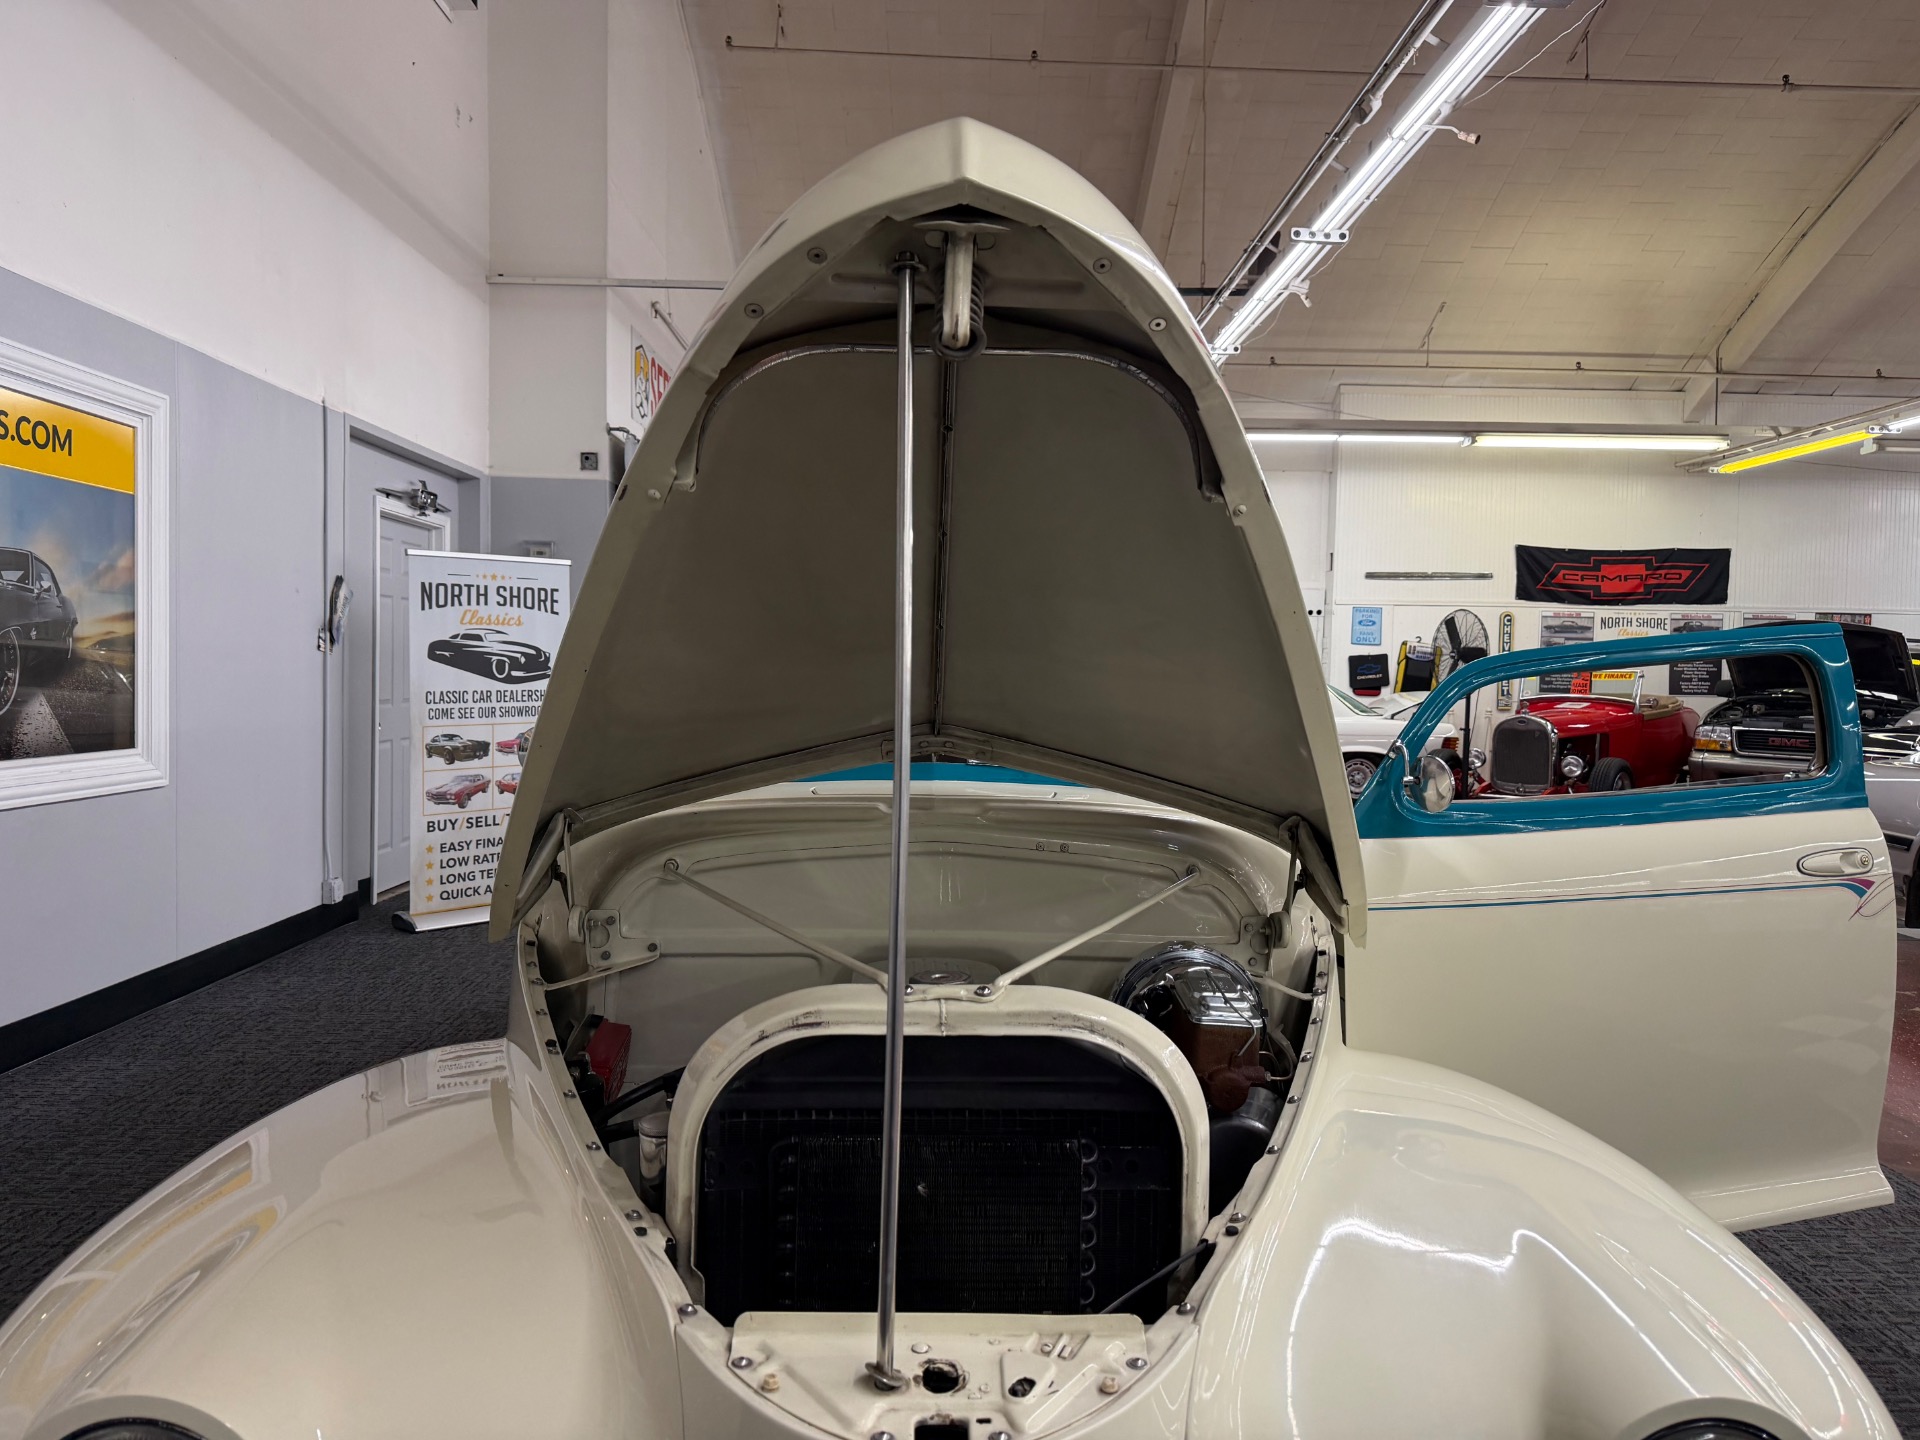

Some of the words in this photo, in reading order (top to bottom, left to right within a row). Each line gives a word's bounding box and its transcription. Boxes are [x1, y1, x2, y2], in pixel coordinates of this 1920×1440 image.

[651, 356, 671, 417] SE
[1562, 572, 1683, 583] CAMARO
[420, 581, 489, 612] NORTH
[496, 585, 560, 616] SHORE
[459, 609, 524, 627] Classics
[1600, 616, 1633, 630] NORTH
[1636, 617, 1668, 631] SHORE
[1617, 628, 1649, 637] Classics
[1502, 616, 1511, 696] CHEVET
[425, 690, 469, 705] CLASSIC
[472, 690, 493, 704] CAR
[428, 707, 455, 720] COME
[458, 707, 475, 720] SEE
[478, 706, 497, 719] OUR
[1768, 737, 1810, 748] GMC
[426, 813, 511, 833] BUY/SELL/
[440, 839, 472, 853] EASY
[440, 856, 470, 870] LOW
[440, 871, 476, 886] LONG
[479, 868, 497, 880] TE
[440, 886, 482, 901] QUICK
